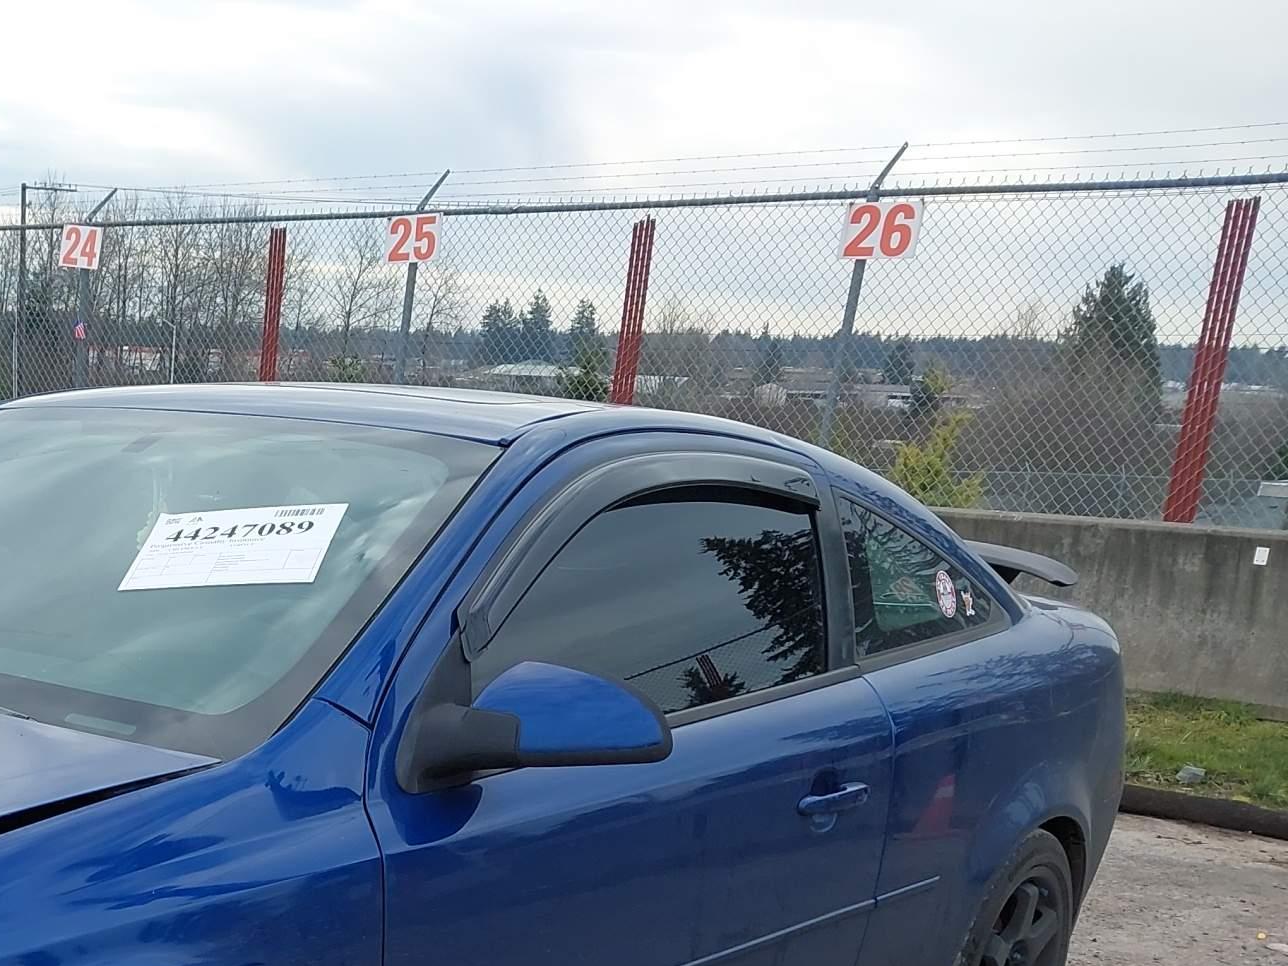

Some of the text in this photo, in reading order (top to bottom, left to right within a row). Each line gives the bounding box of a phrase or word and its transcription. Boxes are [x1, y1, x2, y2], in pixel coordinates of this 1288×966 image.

[62, 226, 98, 267] 24
[388, 215, 437, 262] 25
[842, 203, 916, 257] 26
[166, 520, 315, 542] 44247089
